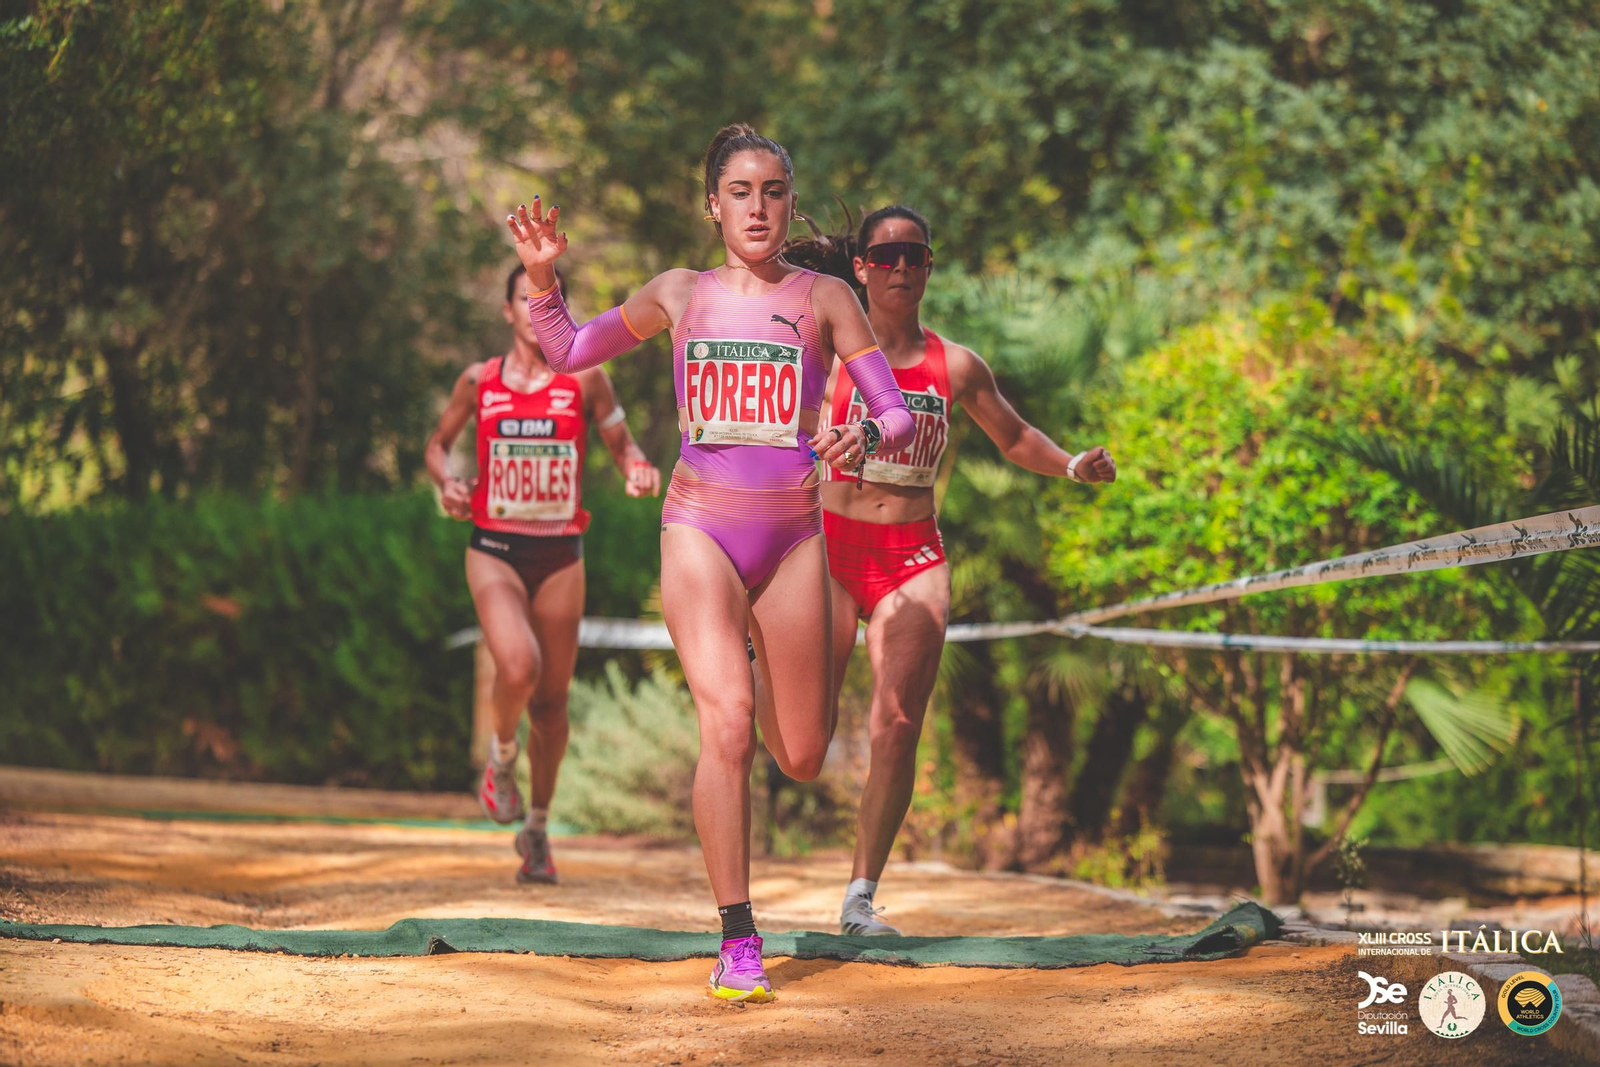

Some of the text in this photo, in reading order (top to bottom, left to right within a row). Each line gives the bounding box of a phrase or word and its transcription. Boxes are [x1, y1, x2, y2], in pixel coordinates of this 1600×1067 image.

[716, 343, 771, 357] ITÁLICA
[687, 361, 797, 425] FORERO
[493, 459, 571, 502] ROBLES
